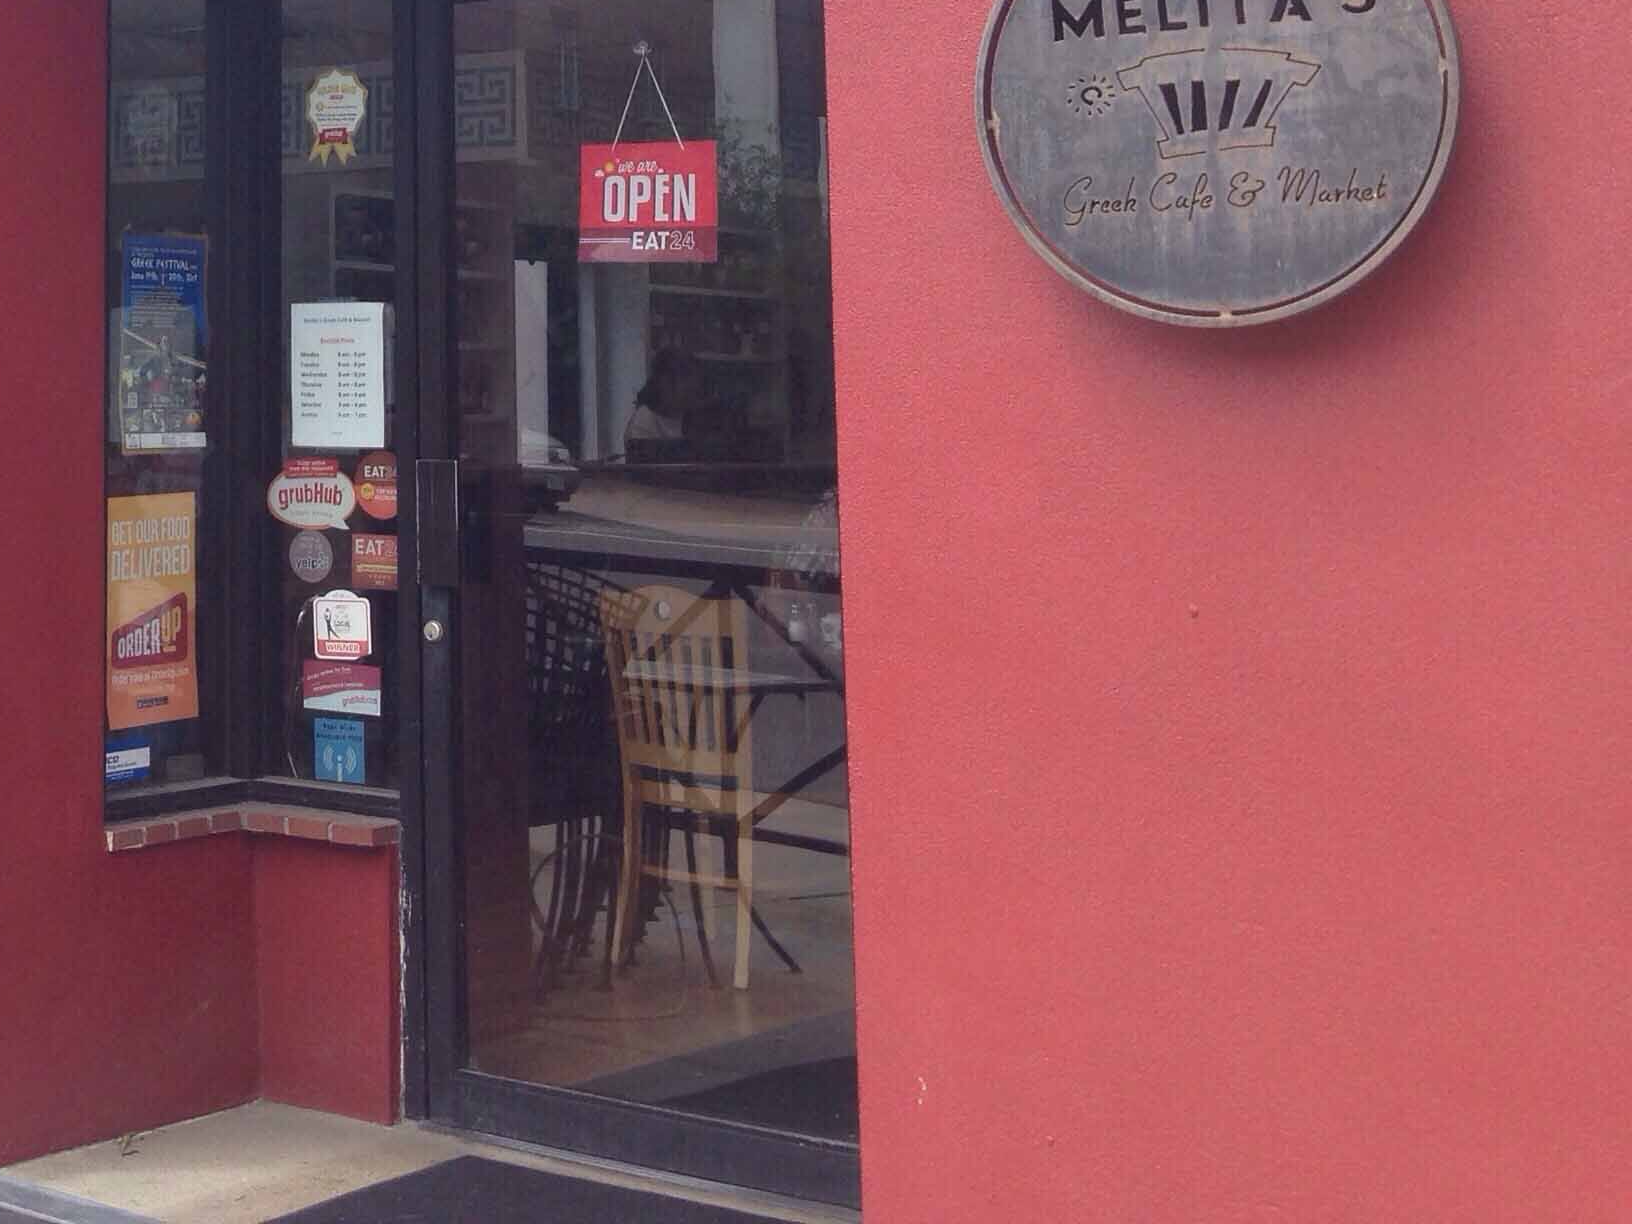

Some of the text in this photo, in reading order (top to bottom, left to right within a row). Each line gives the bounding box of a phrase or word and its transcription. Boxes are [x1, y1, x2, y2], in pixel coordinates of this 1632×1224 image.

[603, 173, 697, 224] OPEN
[1063, 174, 1138, 226] Greek
[1226, 171, 1266, 209] &
[1276, 165, 1388, 207] Market
[631, 230, 696, 251] EAT24
[278, 481, 343, 510] grubHub
[111, 515, 191, 545] GET OUR FOOD
[111, 545, 191, 580] DELIVERED
